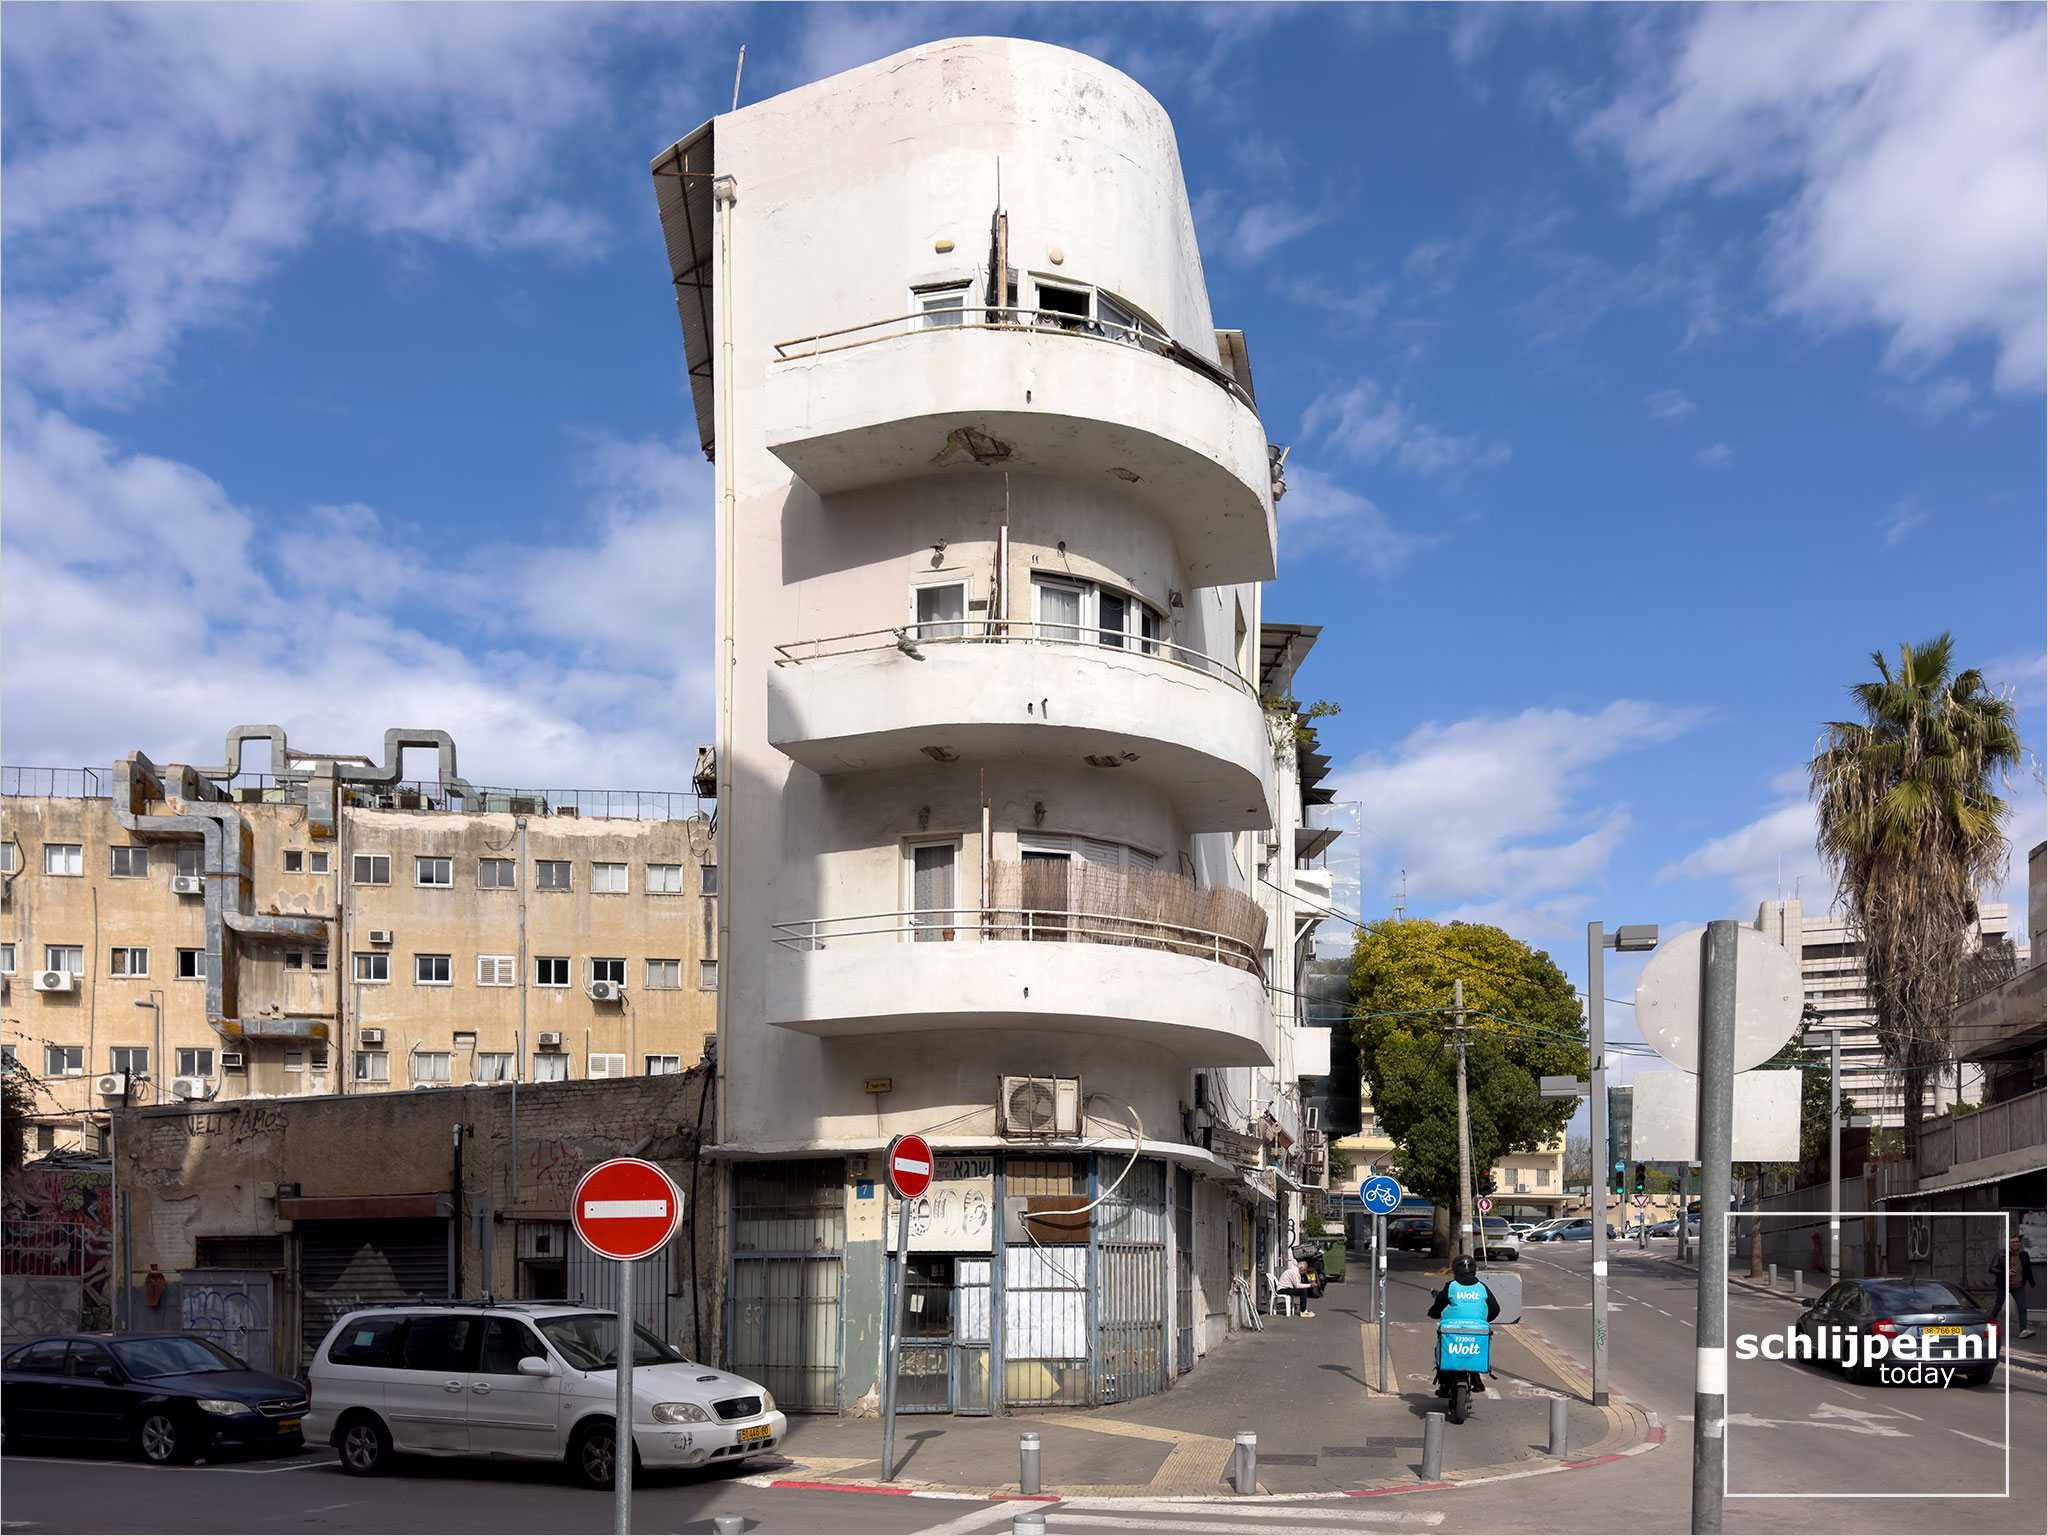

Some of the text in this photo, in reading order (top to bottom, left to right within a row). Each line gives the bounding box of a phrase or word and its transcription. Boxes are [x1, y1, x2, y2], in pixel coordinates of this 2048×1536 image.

[240, 1109, 290, 1131] AMOS
[953, 1160, 991, 1178] שרגא
[862, 1184, 868, 1196] 7
[1456, 1291, 1480, 1300] Wolt
[1448, 1342, 1481, 1355] Wolt
